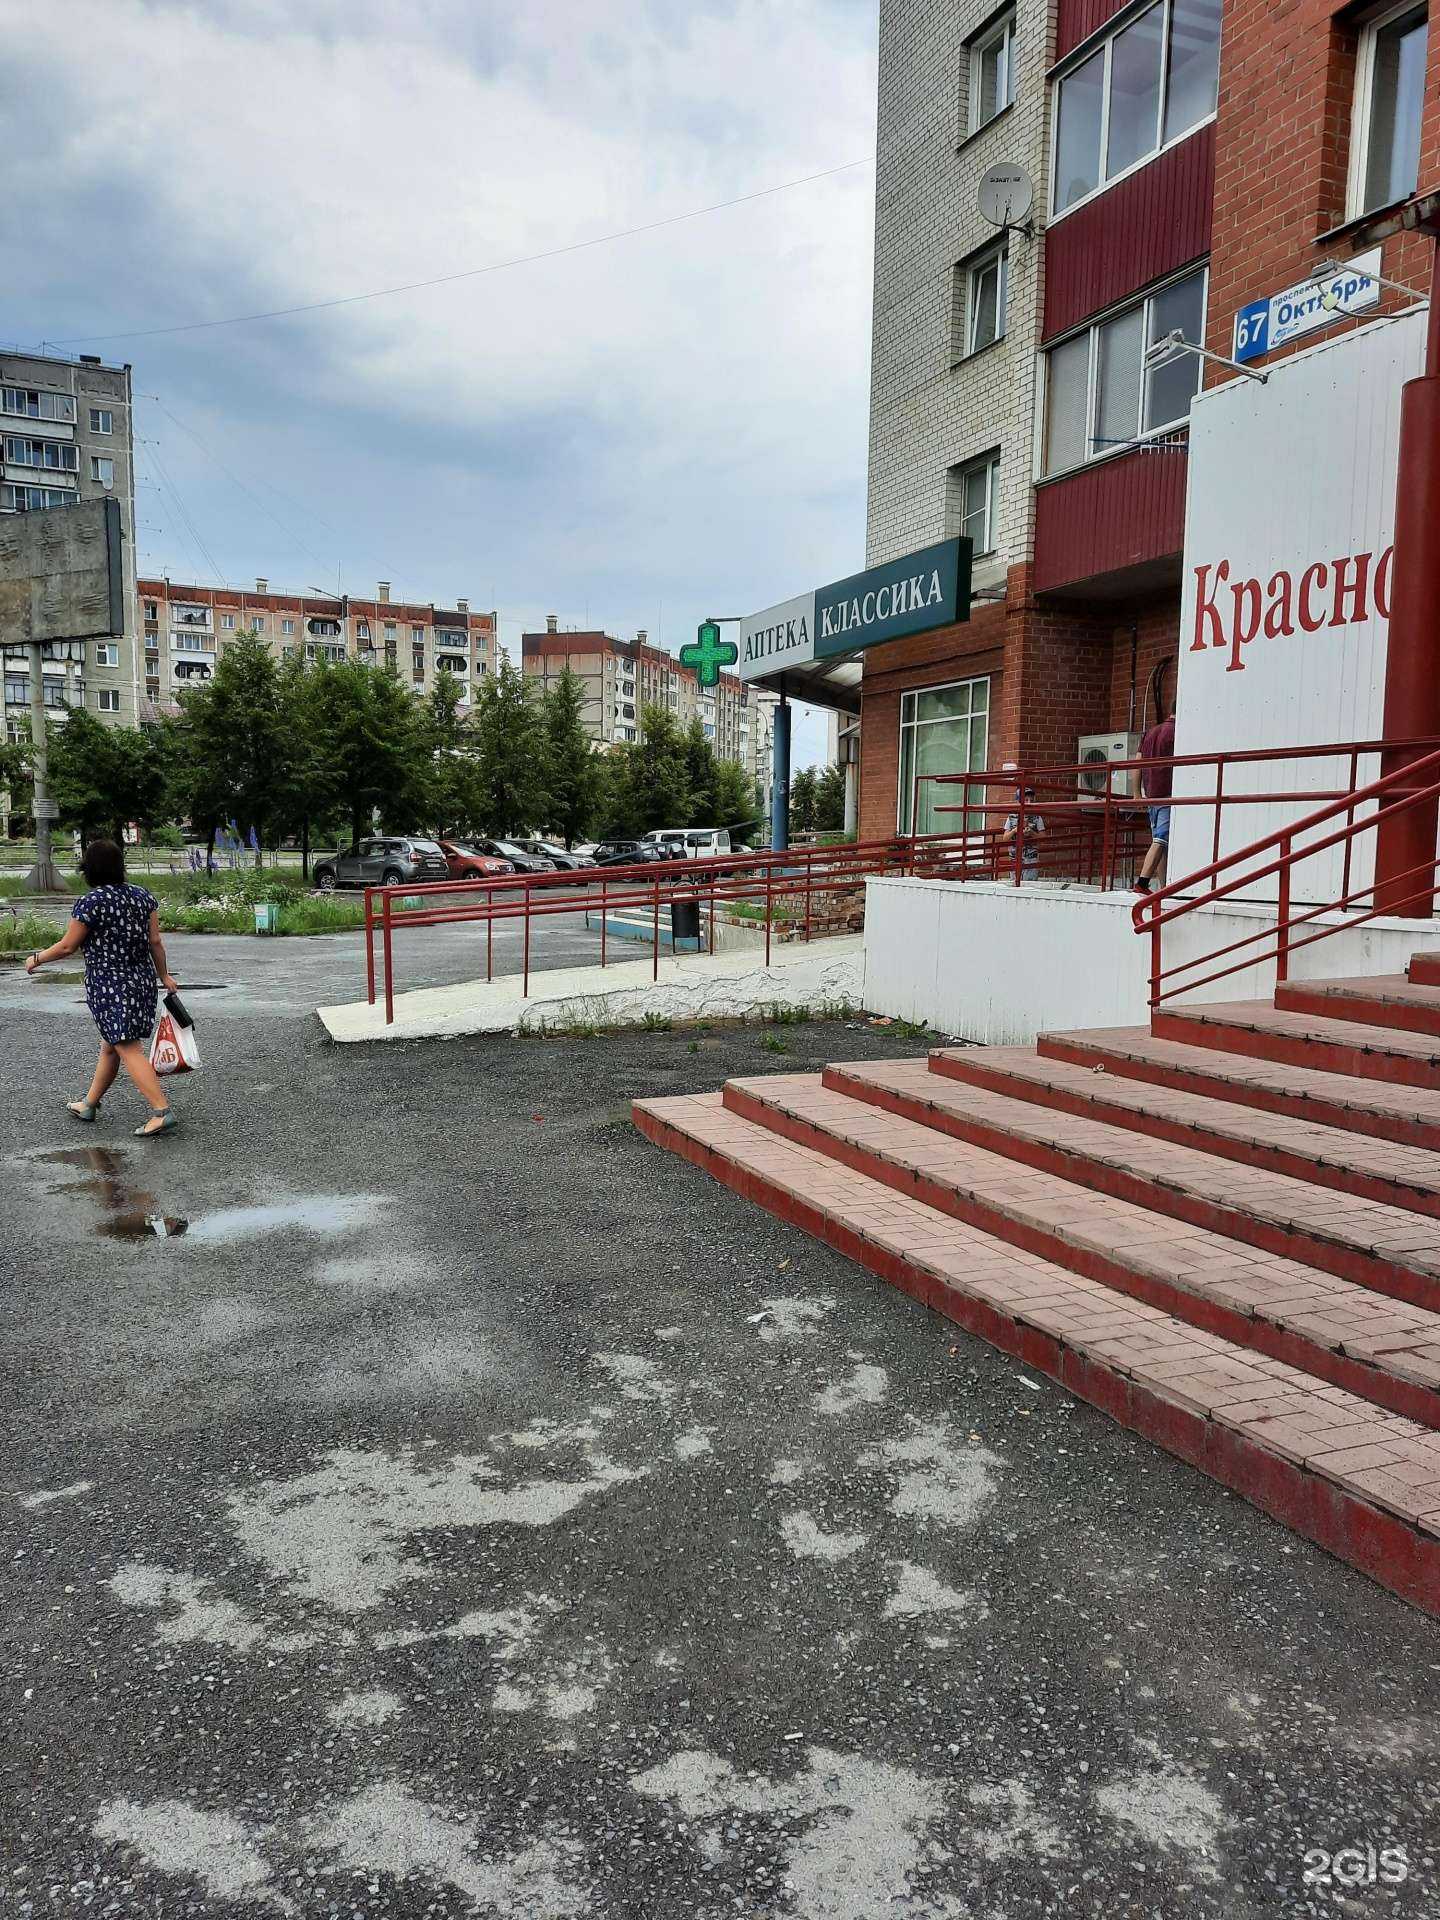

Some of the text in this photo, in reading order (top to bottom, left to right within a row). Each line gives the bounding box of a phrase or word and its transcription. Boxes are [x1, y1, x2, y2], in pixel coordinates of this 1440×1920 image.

[1237, 311, 1268, 349] 67
[743, 568, 943, 663] АПТЕКА КЛАССИКА
